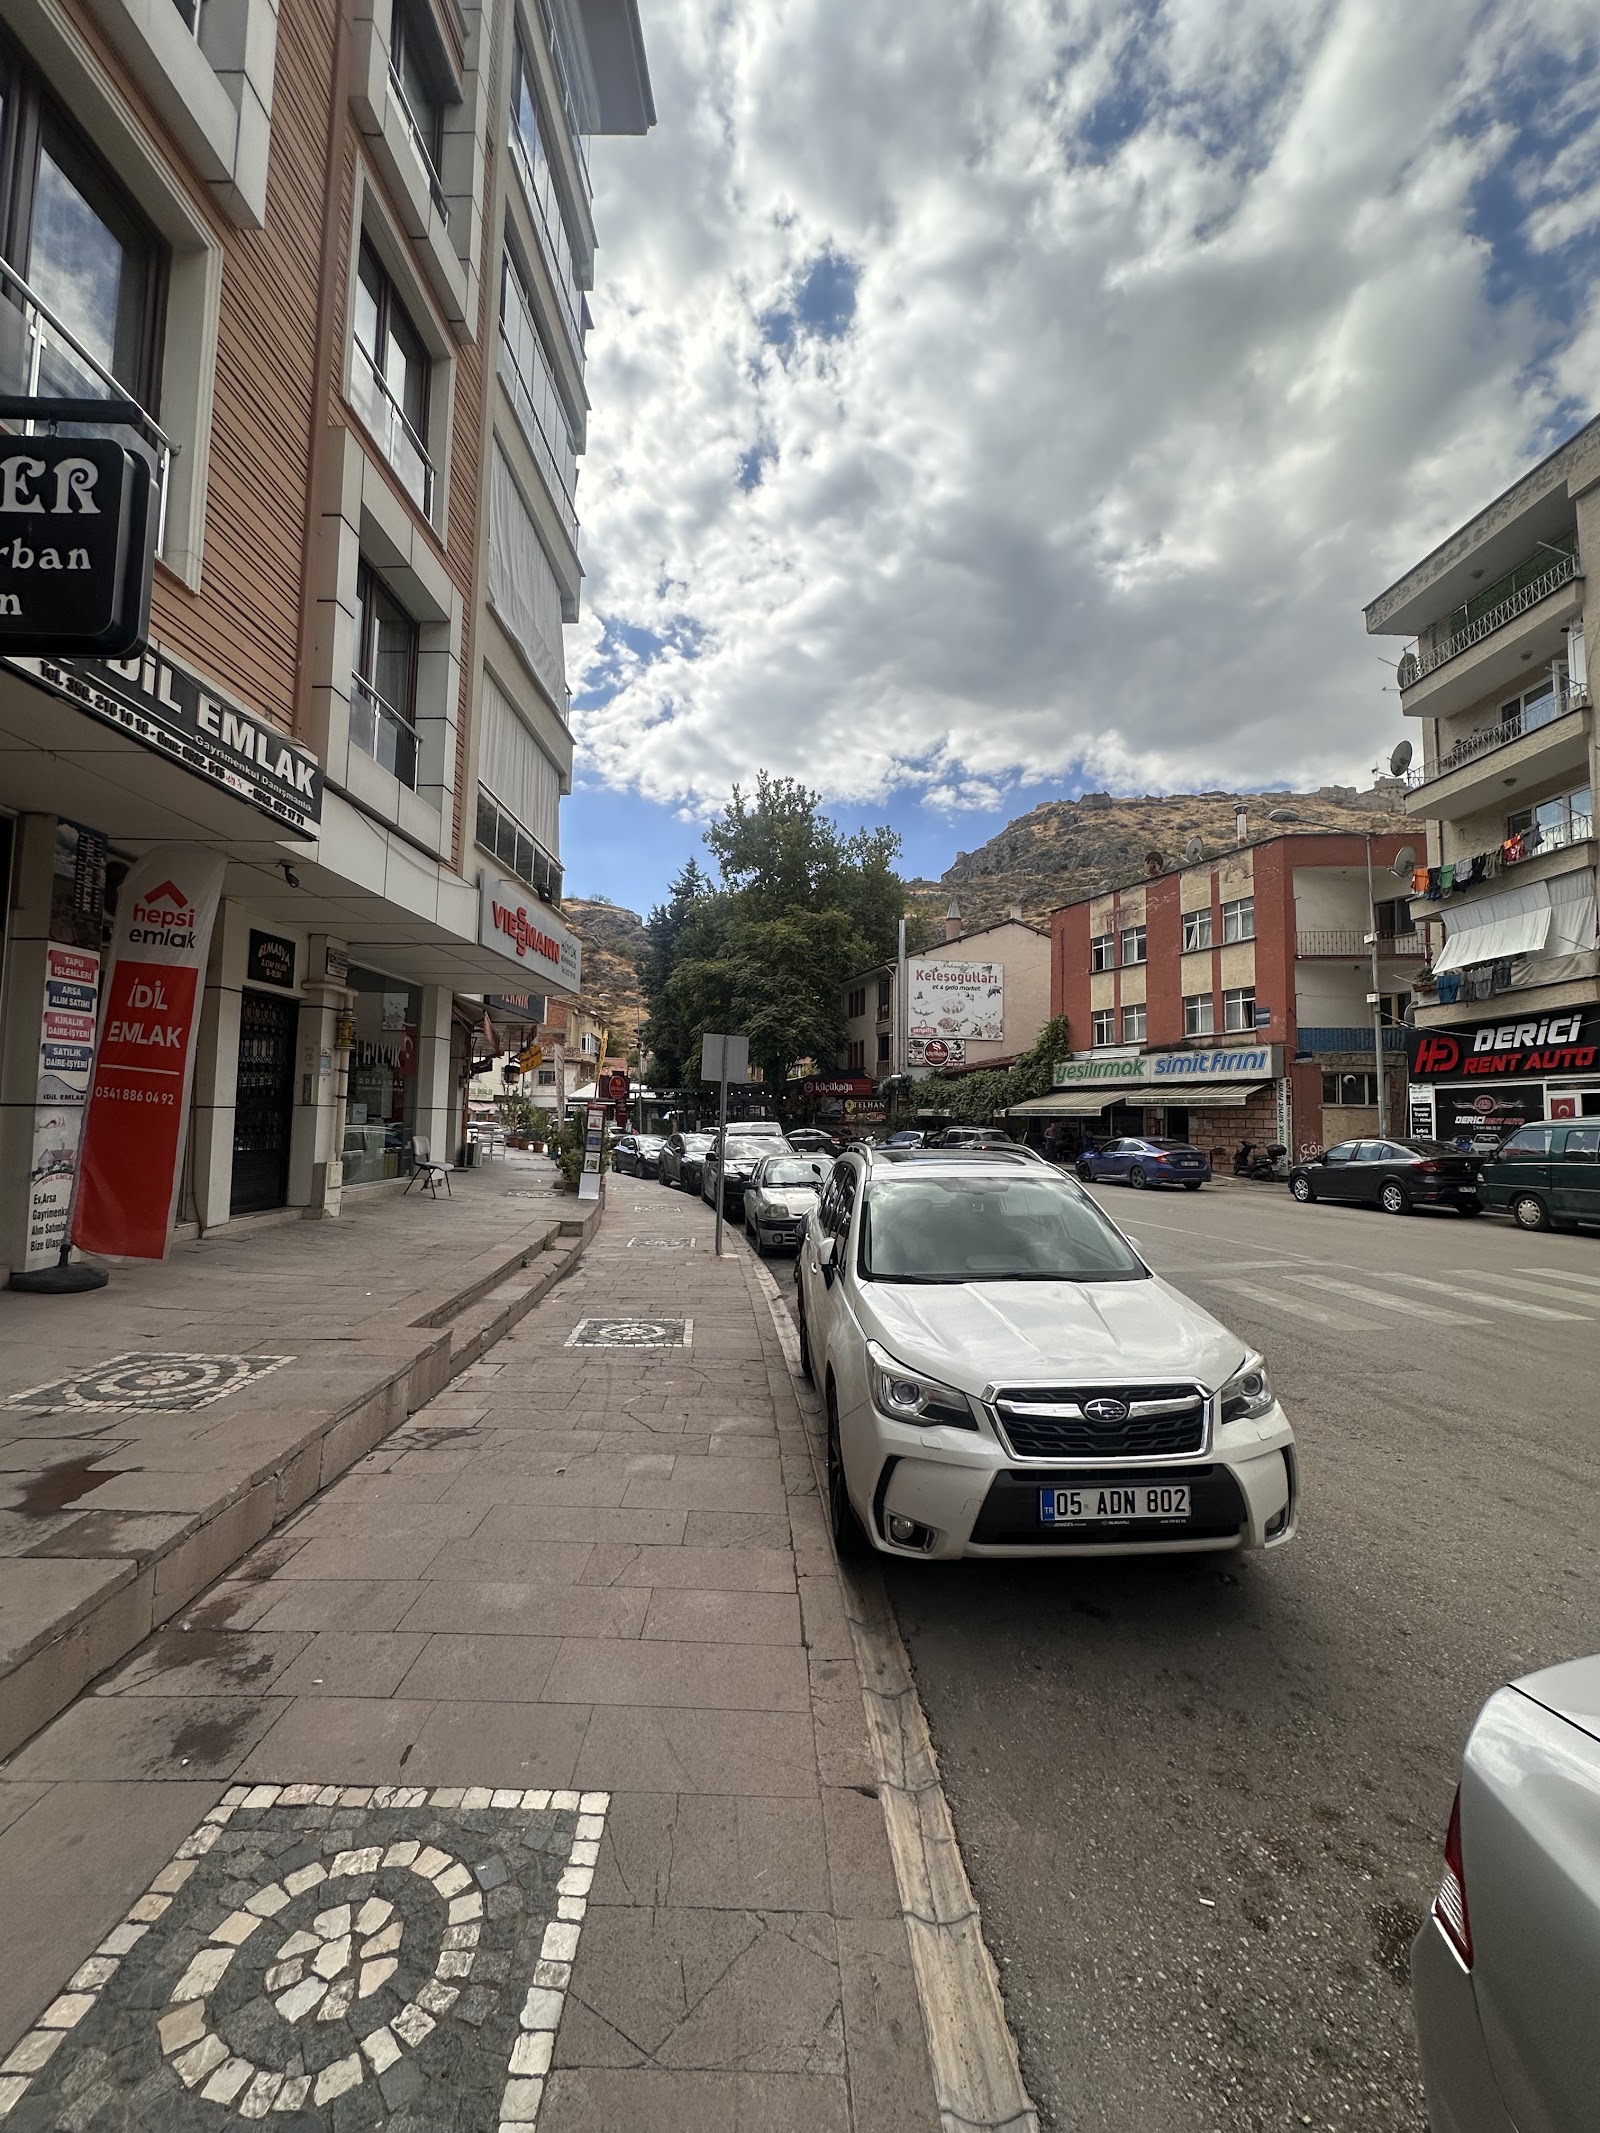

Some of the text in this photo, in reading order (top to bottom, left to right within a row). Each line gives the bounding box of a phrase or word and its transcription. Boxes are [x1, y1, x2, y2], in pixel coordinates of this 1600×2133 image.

[197, 692, 316, 800] EMLAK
[194, 734, 313, 814] Gayrimenkul Danışmanlık
[132, 903, 195, 928] hepsi
[129, 928, 198, 949] emlak
[492, 900, 560, 965] VIESSMANN
[64, 956, 84, 968] TAPU
[54, 965, 93, 981] İŞLEMLERİ
[61, 985, 82, 997] ARSA
[126, 977, 168, 1010] İDİL
[51, 995, 91, 1010] ALIM SATIMI
[55, 1013, 84, 1027] KİRALIK
[48, 1026, 90, 1040] DAİRE-İŞYERİ
[107, 1021, 184, 1049] EMLAK
[53, 1047, 82, 1057] SATILIK
[1056, 1059, 1146, 1085] yeşilırmak
[1154, 1053, 1210, 1076] simit
[1211, 1050, 1269, 1074] fırını
[1463, 1046, 1599, 1075] RENT AUTO
[815, 1081, 853, 1094] küçükağa
[60, 1093, 86, 1101] EMLAK
[95, 1086, 174, 1106] 0541 886 04 92
[32, 1206, 68, 1222] Gayrimenku
[45, 1222, 66, 1234] Satımla
[30, 1240, 44, 1252] Bize
[1044, 1488, 1187, 1516] TR 05 ADN 802
